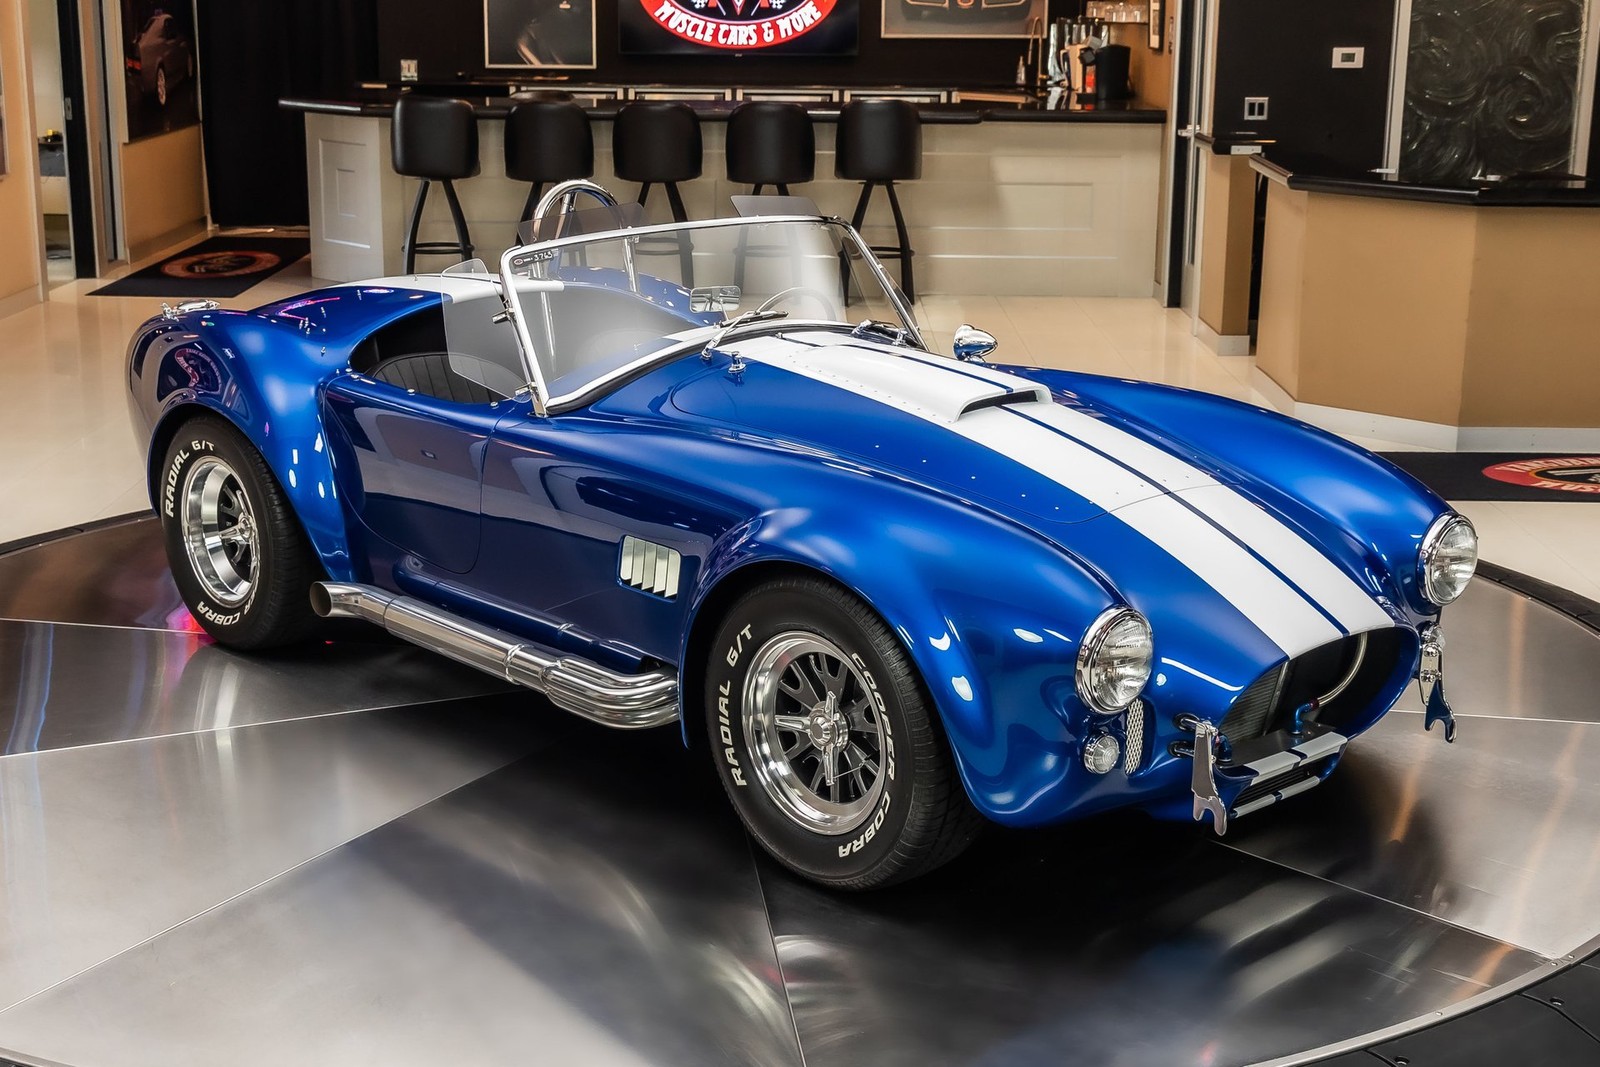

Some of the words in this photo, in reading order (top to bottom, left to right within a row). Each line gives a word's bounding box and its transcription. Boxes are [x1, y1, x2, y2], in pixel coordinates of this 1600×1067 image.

[653, 1, 717, 43] MUSCLE
[717, 23, 758, 46] CARS
[761, 21, 775, 43] &
[775, 0, 823, 39] MORE
[165, 449, 190, 518] RADIAL
[191, 439, 215, 452] G/T
[1531, 480, 1600, 492] MUS
[196, 600, 241, 626] COBRA
[726, 623, 752, 668] G/T
[718, 679, 748, 787] RADIAL
[851, 652, 895, 781] COOPER
[838, 790, 891, 858] COBRA
